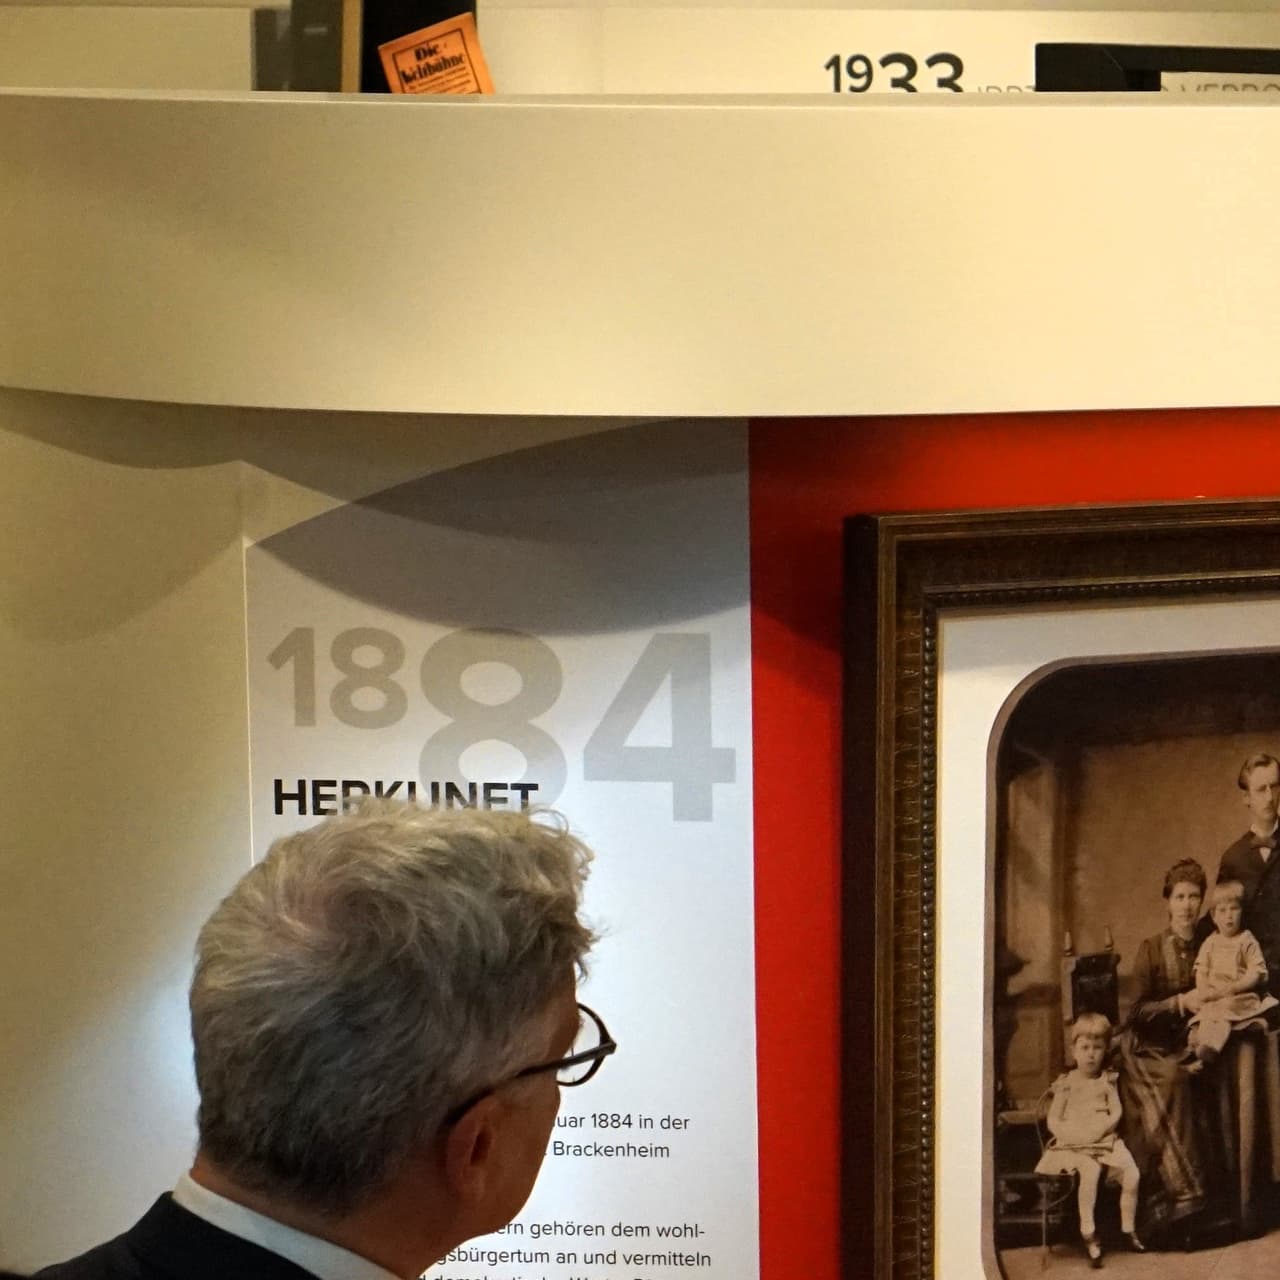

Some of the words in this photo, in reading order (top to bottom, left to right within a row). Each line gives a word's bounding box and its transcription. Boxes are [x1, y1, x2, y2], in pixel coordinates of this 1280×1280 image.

[265, 626, 738, 823] 1884
[590, 1112, 633, 1129] 1884
[638, 1113, 654, 1130] in
[659, 1114, 691, 1131] der
[553, 1140, 670, 1159] Brackenheim
[529, 1220, 605, 1240] gehören
[610, 1221, 651, 1238] dem
[656, 1223, 705, 1239] wohl-
[555, 1251, 577, 1265] an
[583, 1249, 617, 1265] und
[622, 1250, 712, 1267] vermitteln
